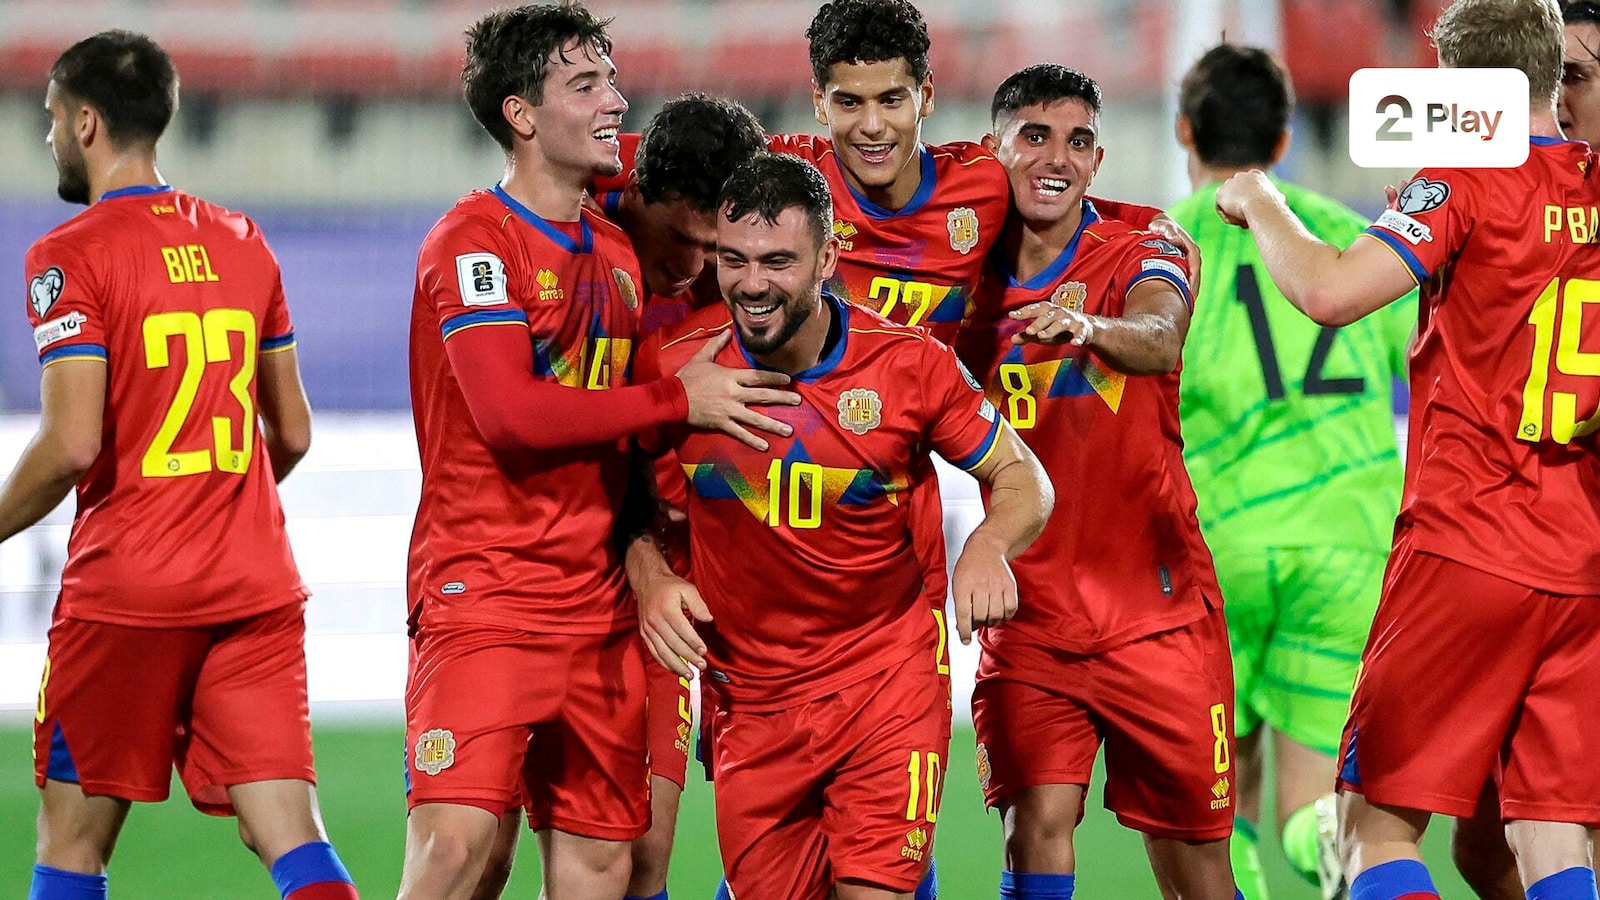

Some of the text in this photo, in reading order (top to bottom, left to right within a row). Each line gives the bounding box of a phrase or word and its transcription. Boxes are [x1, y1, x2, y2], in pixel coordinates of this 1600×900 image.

[161, 244, 219, 283] BIEL
[141, 308, 257, 477] 23
[1000, 363, 1036, 429] 8
[767, 459, 824, 528] 10
[1210, 703, 1230, 774] 8
[906, 750, 941, 823] 10
